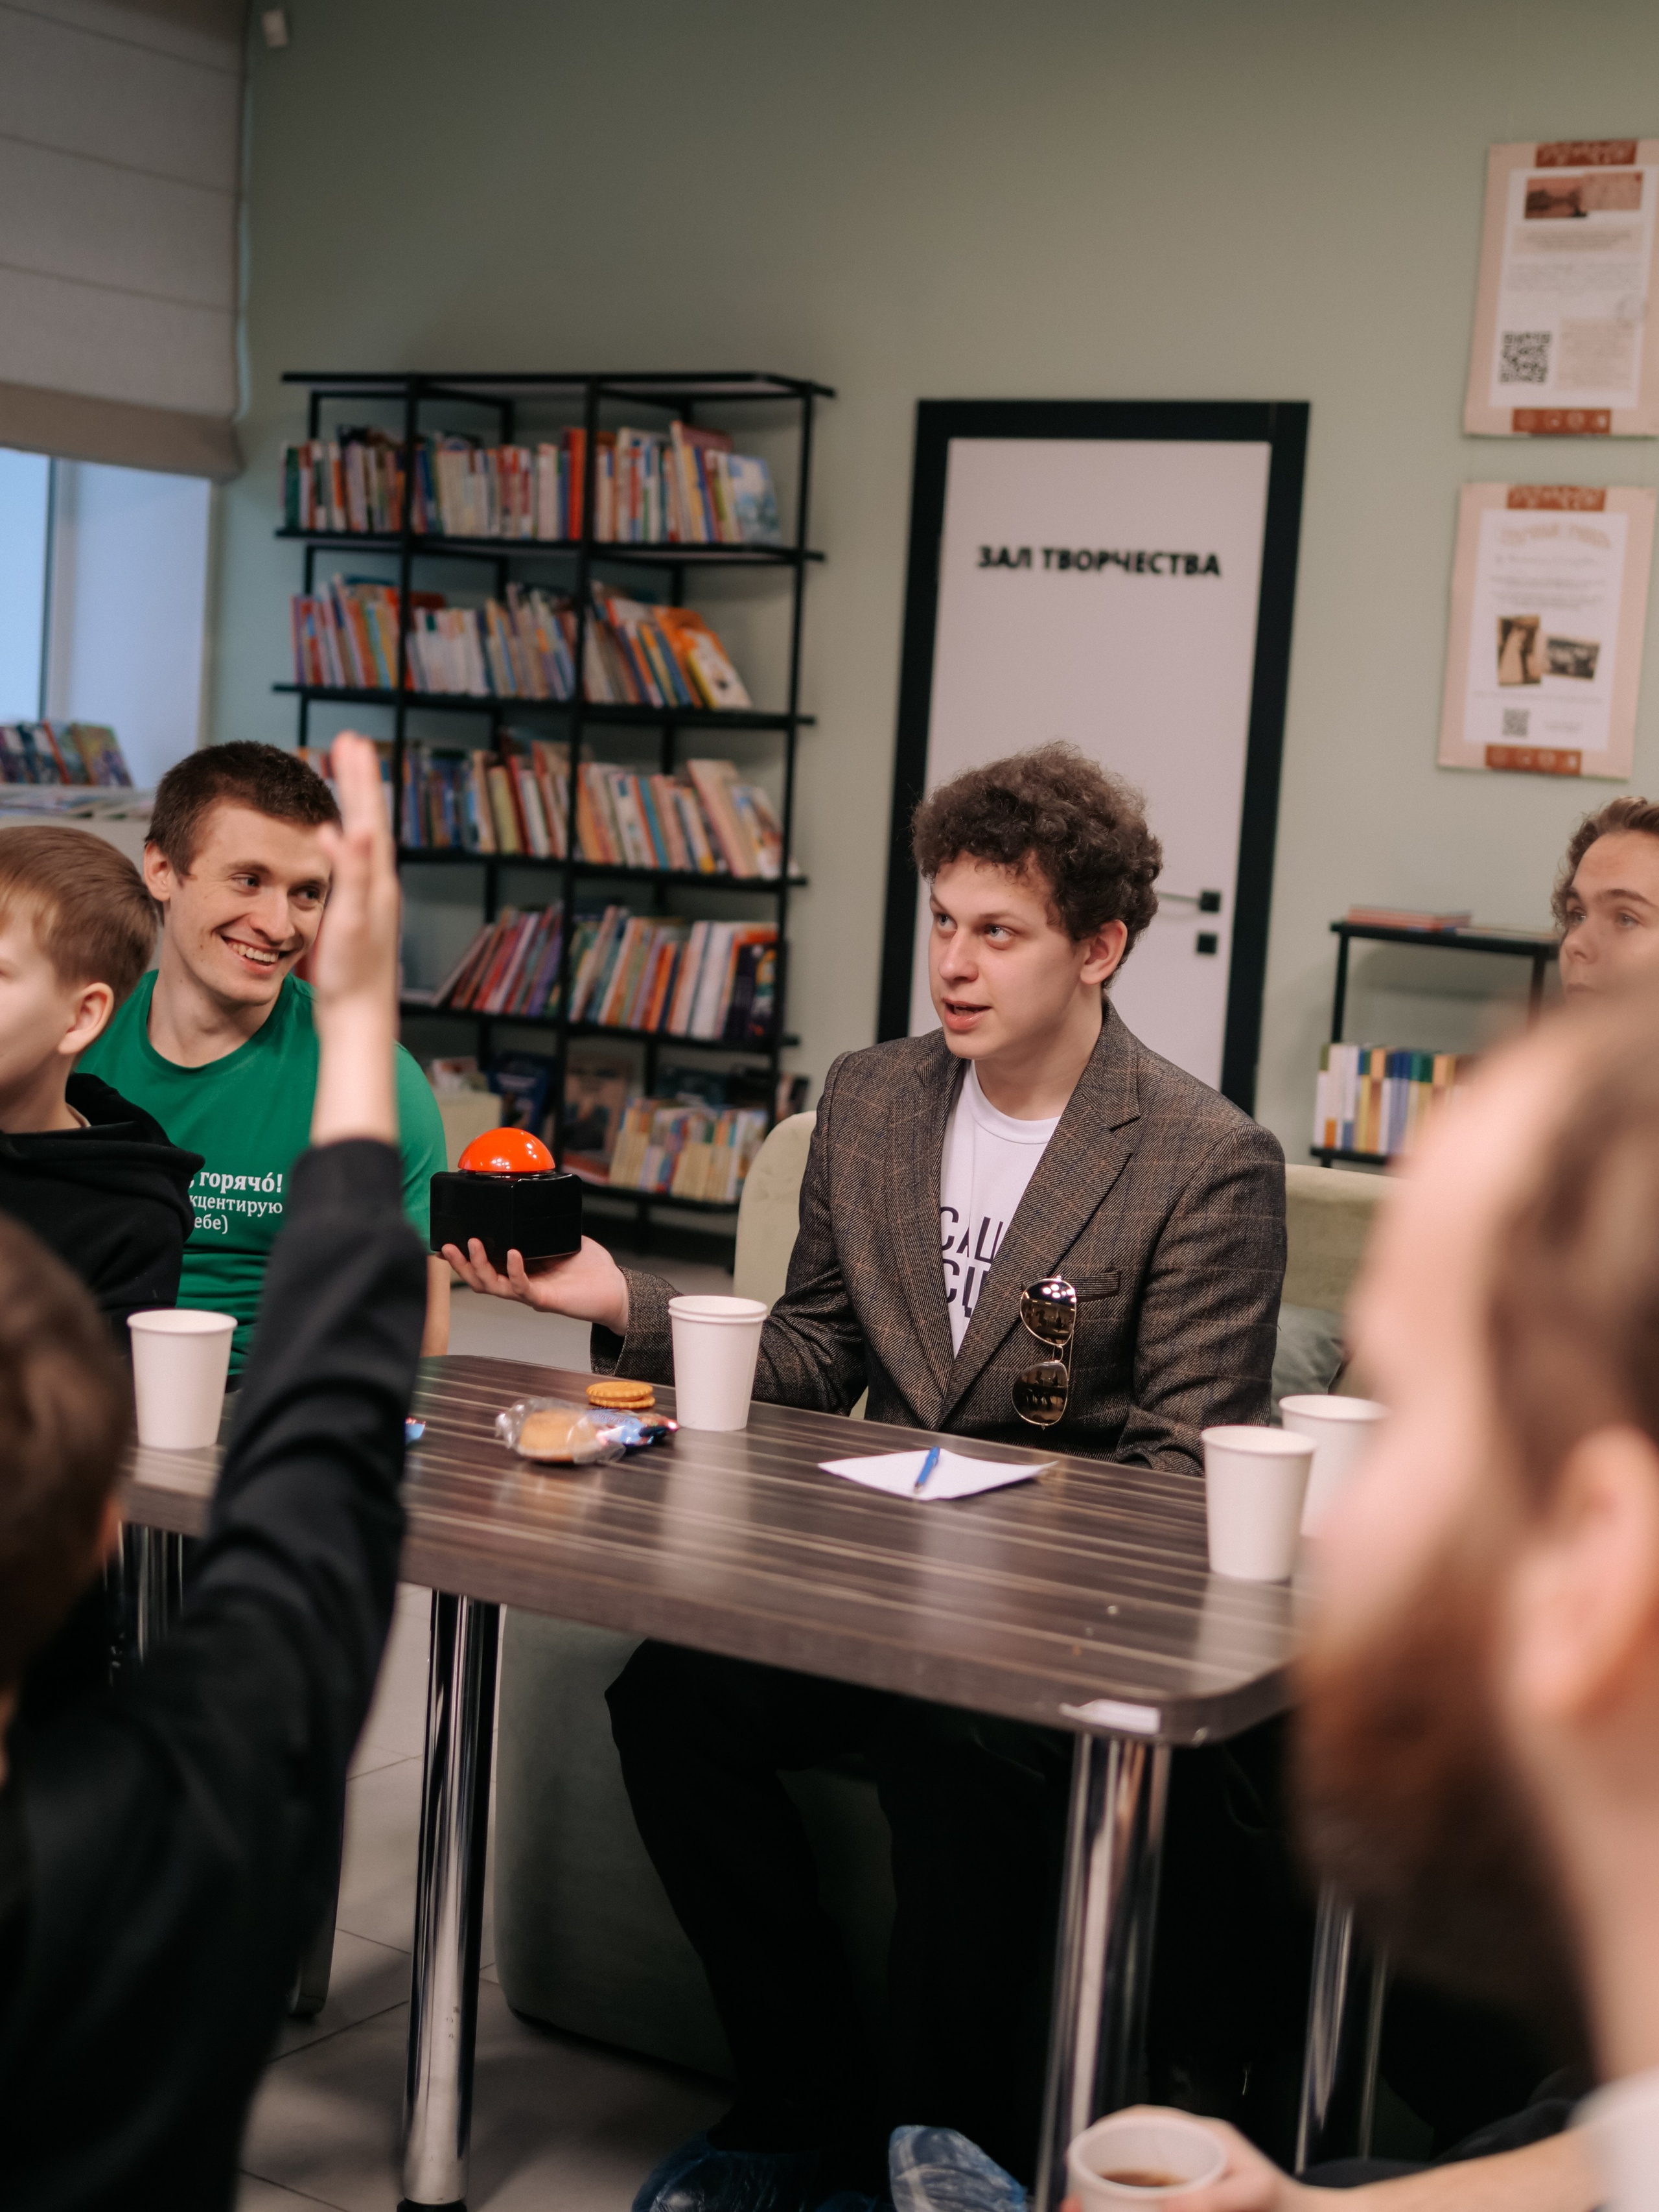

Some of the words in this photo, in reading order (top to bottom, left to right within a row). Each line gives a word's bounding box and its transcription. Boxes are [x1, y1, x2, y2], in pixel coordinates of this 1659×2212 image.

[979, 546, 1032, 569] ЗАЛ
[1042, 548, 1221, 576] ТВОРЧЕСТВА
[189, 1194, 283, 1217] кцентирую
[194, 1213, 229, 1234] ебе)
